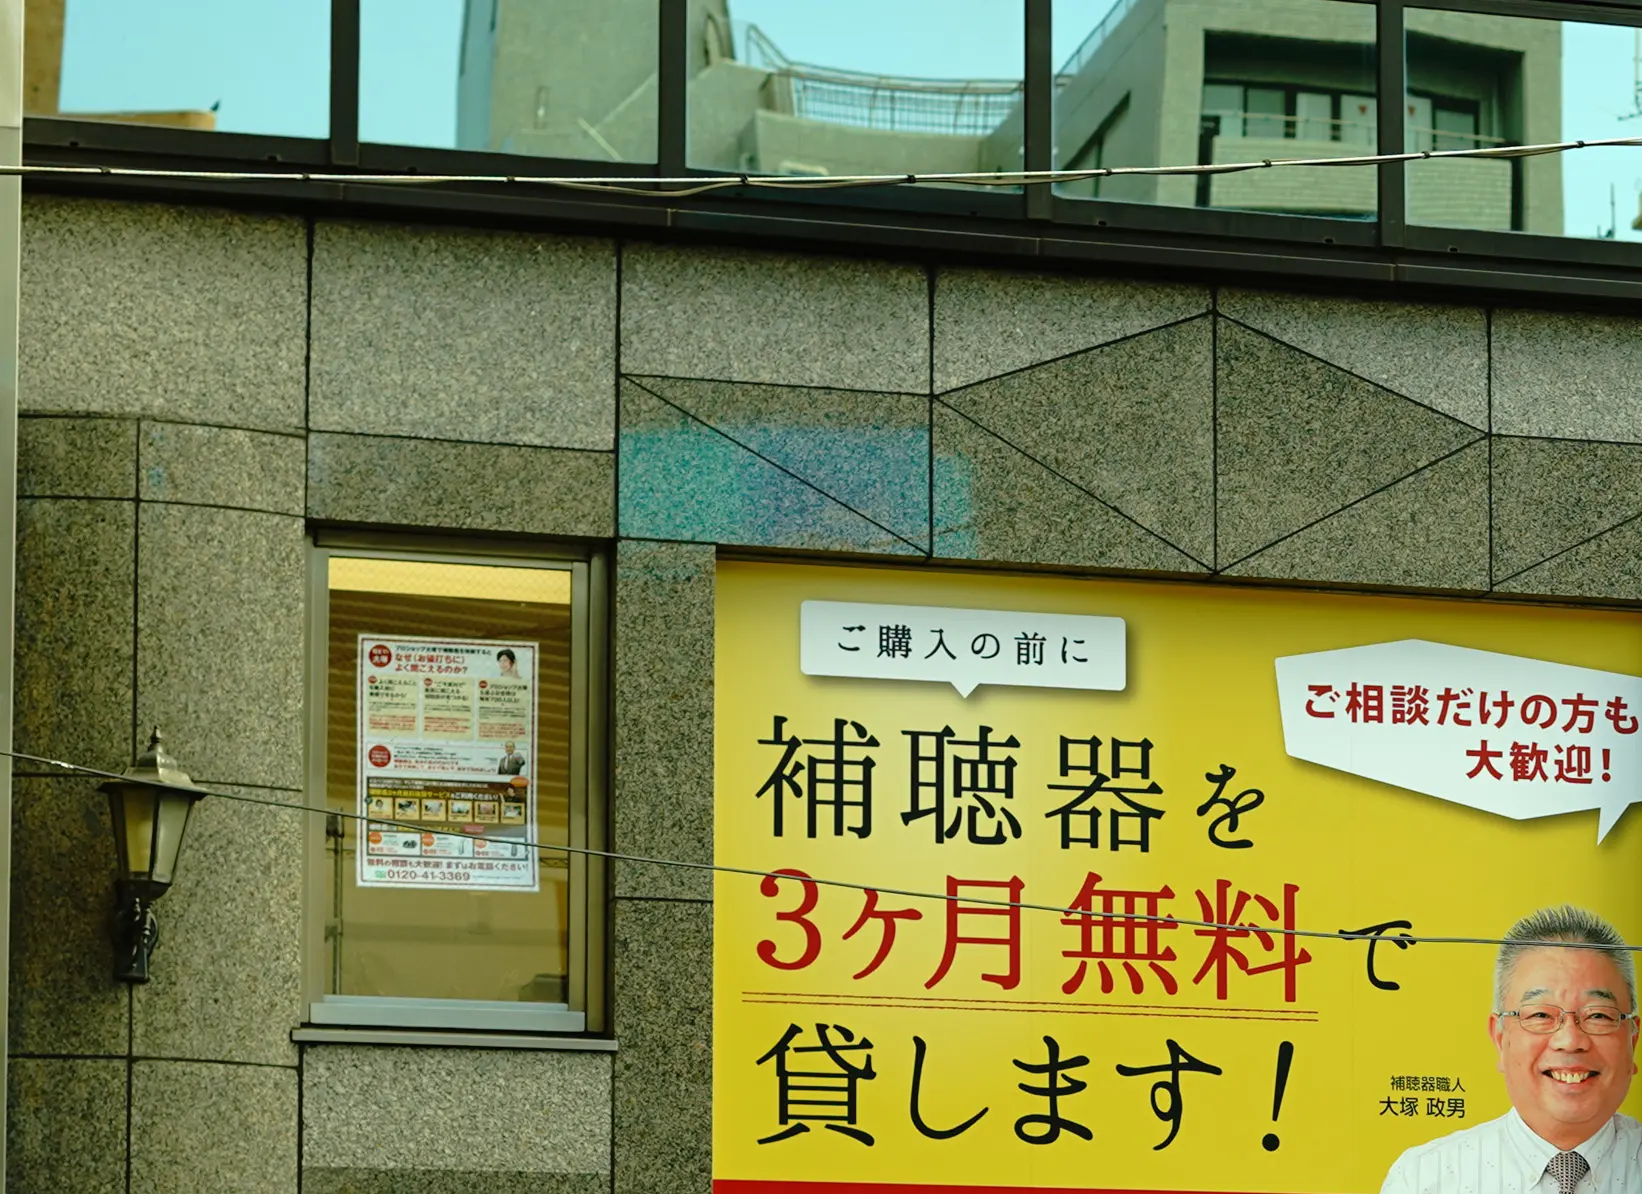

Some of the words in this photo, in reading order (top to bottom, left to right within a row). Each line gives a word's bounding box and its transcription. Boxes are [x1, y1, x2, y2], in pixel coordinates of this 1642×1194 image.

[836, 622, 1090, 666] ご購入の前に
[1304, 682, 1639, 735] ご相談だけの方も
[756, 715, 1266, 852] 補聴器を
[1465, 739, 1612, 784] 大歓迎!
[388, 869, 470, 881] 0120-41-3369
[756, 1022, 1295, 1152] 貸します!
[1389, 1075, 1466, 1094] 補聴器職人
[1379, 1095, 1419, 1119] 大塚
[1425, 1097, 1466, 1119] 政男
